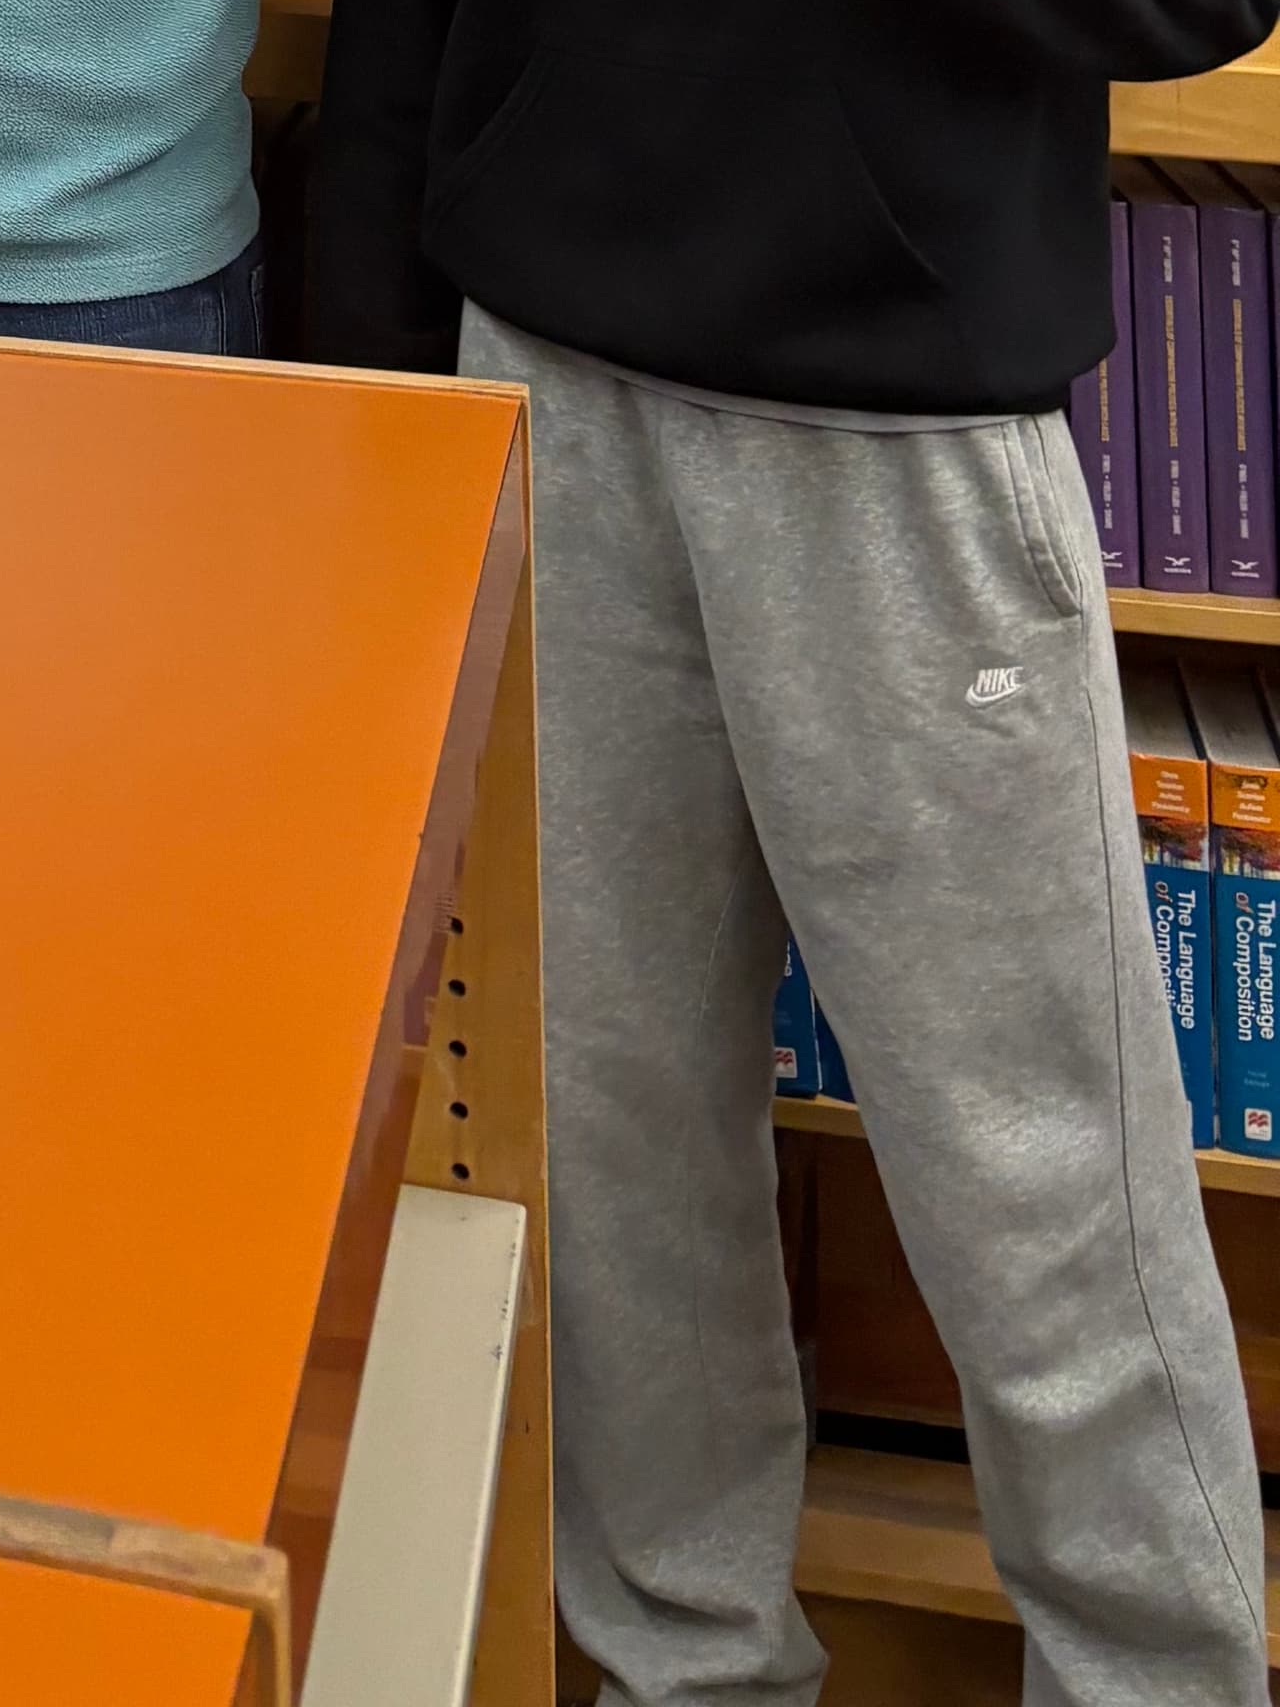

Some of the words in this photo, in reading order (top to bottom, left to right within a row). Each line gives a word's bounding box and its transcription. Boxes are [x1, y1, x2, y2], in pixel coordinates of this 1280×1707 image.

[975, 667, 1023, 692] NIKE
[1155, 881, 1173, 903] of
[1178, 890, 1196, 927] The
[1236, 892, 1254, 914] of
[1258, 900, 1276, 937] The
[1176, 931, 1197, 1029] Language
[1233, 916, 1256, 1041] Composition
[1255, 942, 1277, 1040] Language
